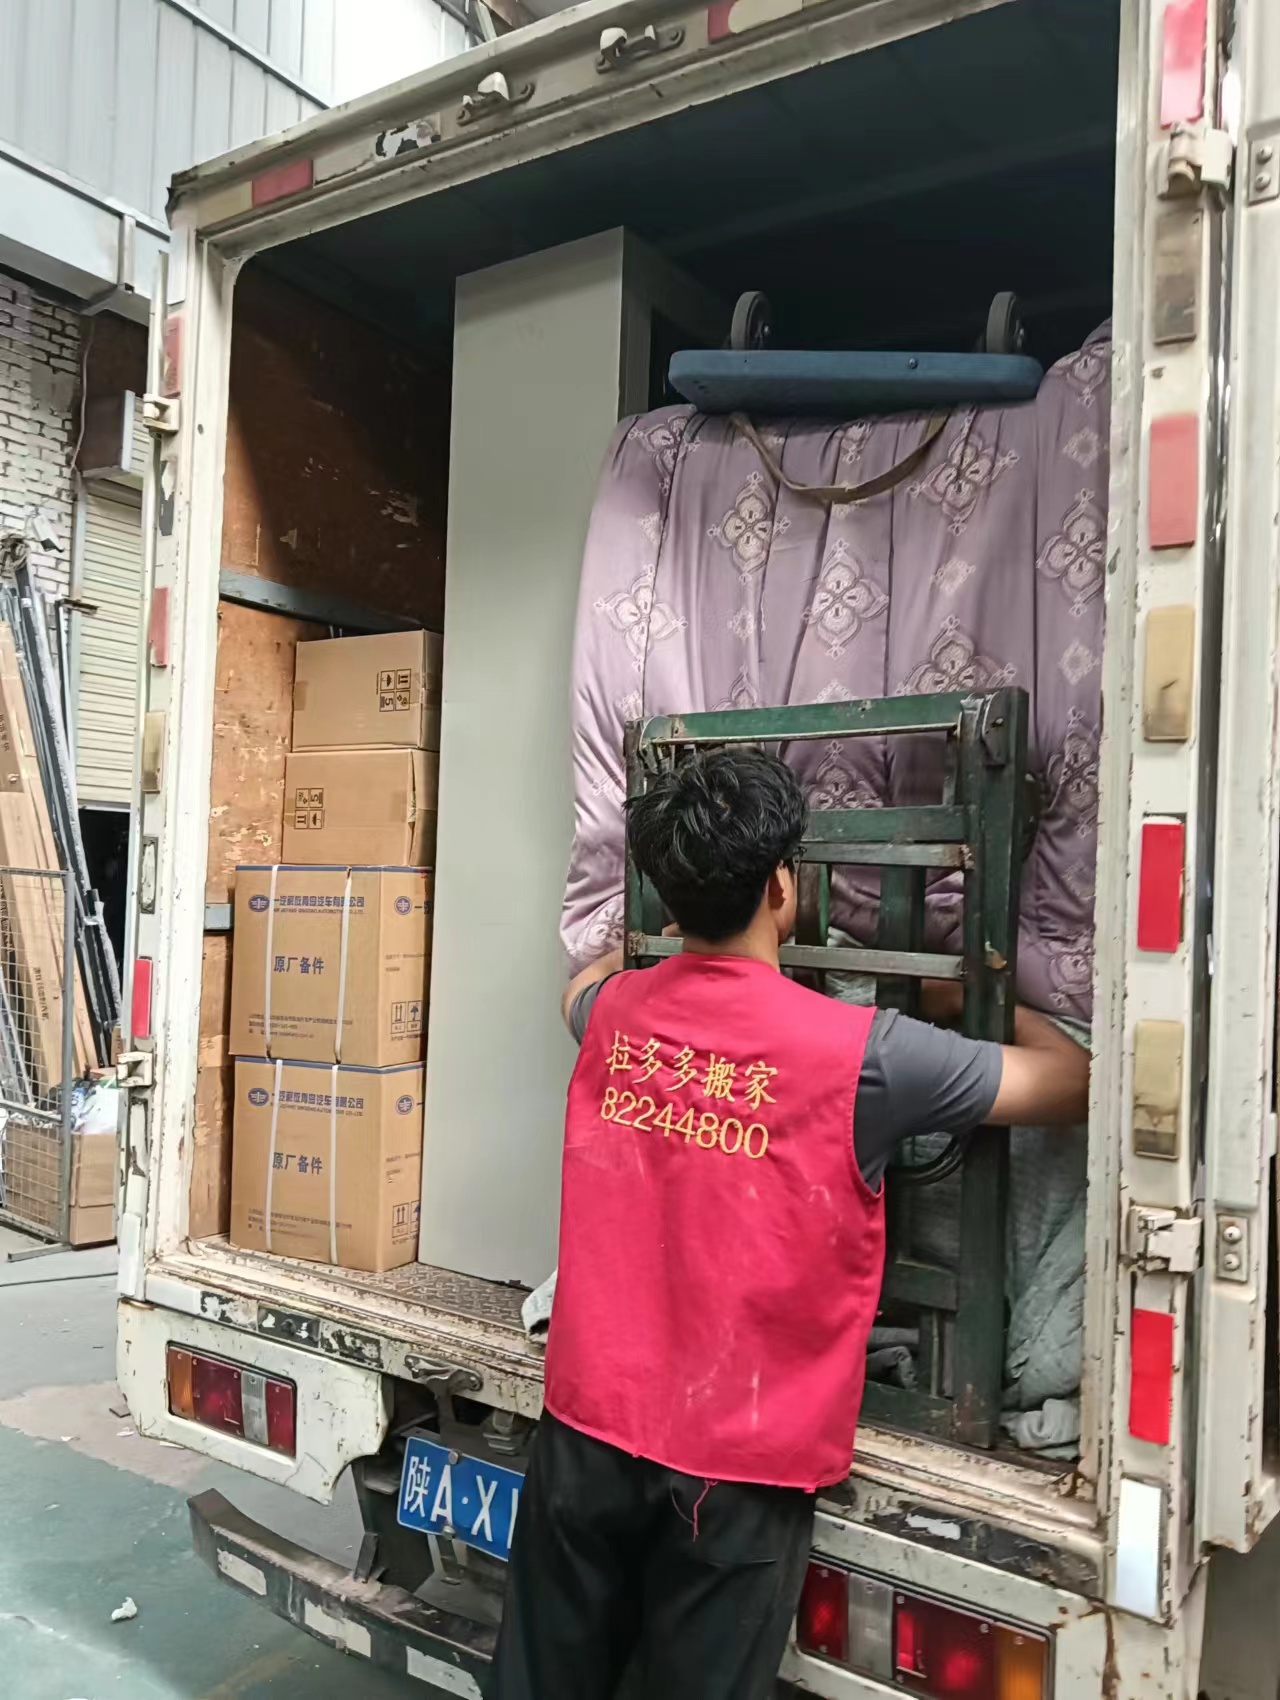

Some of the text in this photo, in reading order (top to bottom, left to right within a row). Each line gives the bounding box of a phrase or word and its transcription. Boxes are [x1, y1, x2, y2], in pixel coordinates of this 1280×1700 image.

[273, 955, 325, 975] 原厂备件
[605, 1030, 778, 1110] 拉多多搬家
[600, 1087, 769, 1159] 82244800
[272, 1151, 323, 1175] 原厂备件
